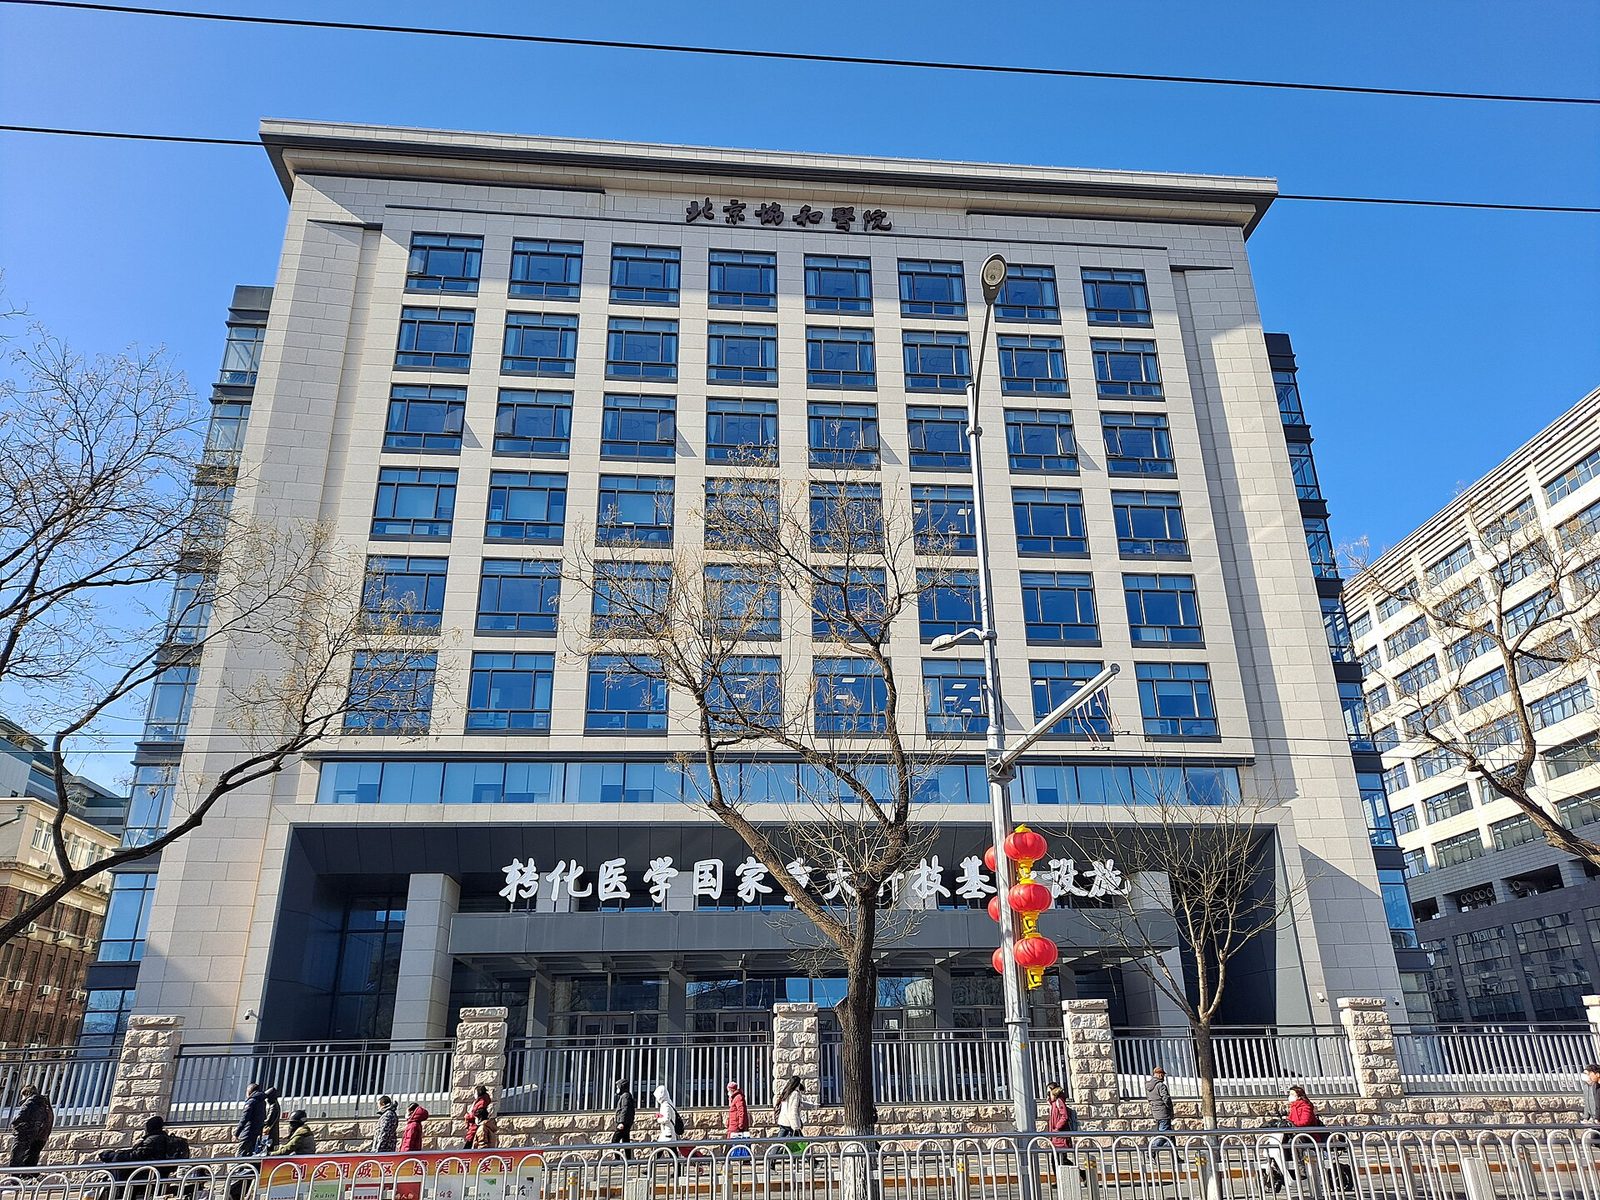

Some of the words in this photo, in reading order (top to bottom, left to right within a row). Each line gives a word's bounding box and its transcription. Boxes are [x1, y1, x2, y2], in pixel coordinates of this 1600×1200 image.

[498, 854, 1132, 904] 转化医学国家大技基设施
[291, 1162, 394, 1180] 创文明城区
[413, 1157, 514, 1176] 建美丽家园
